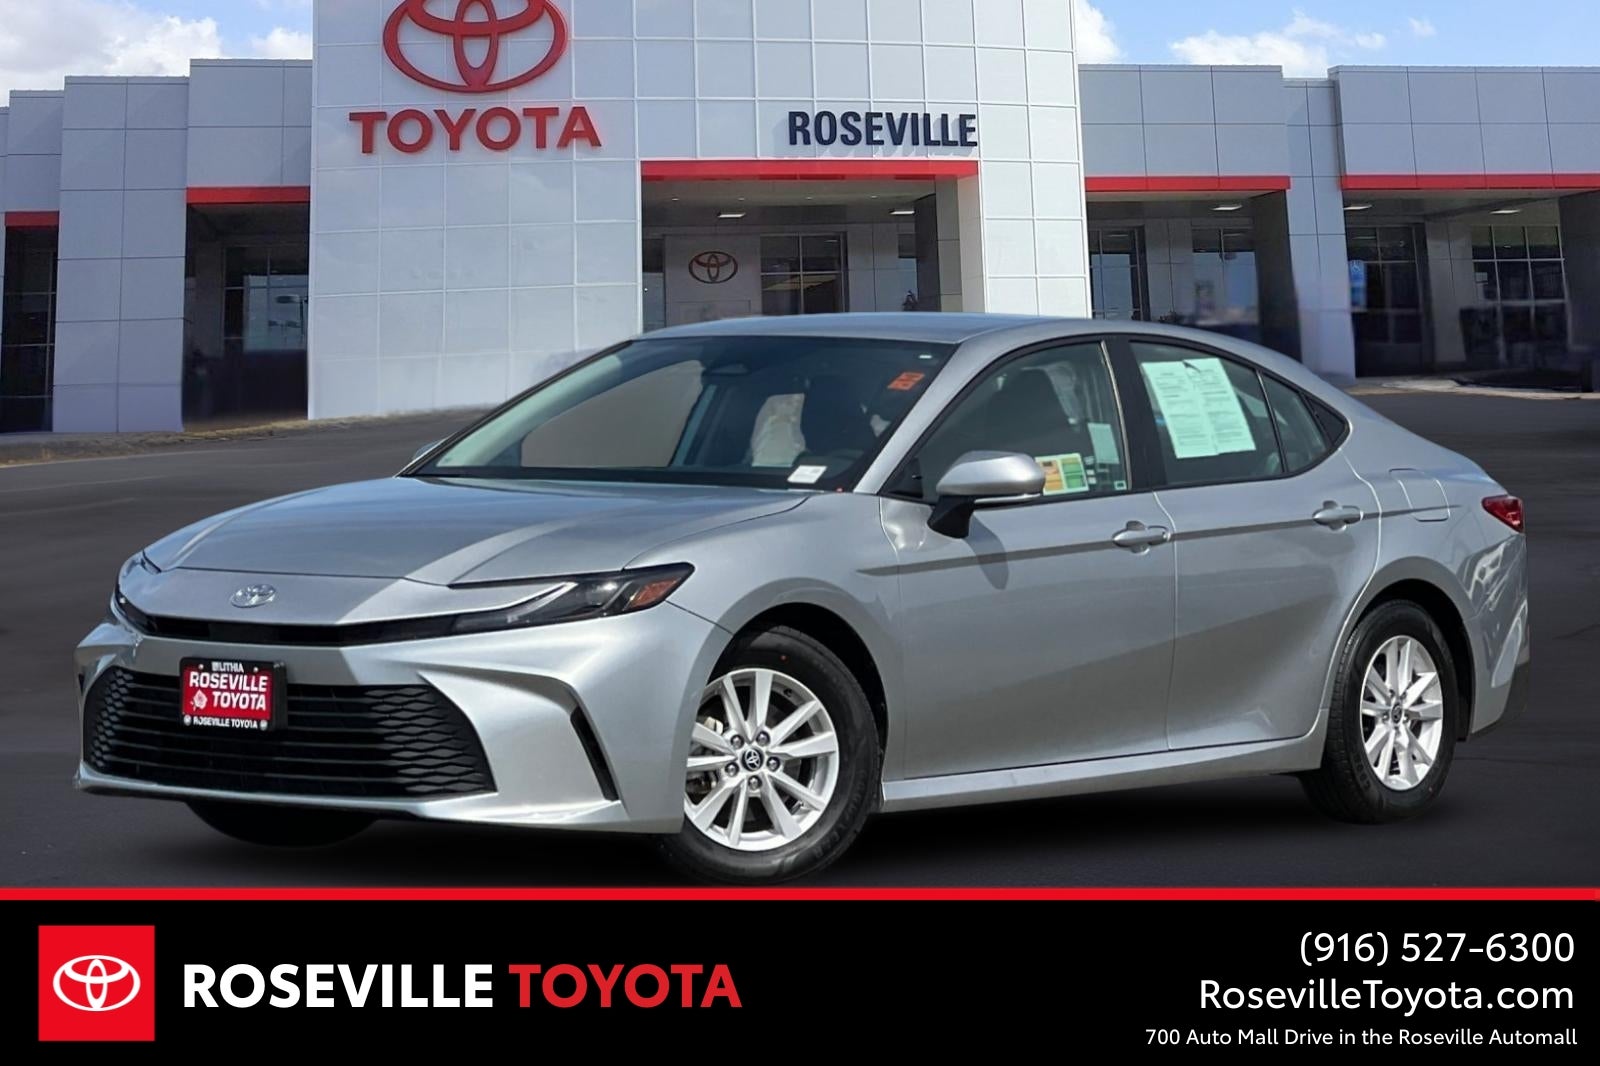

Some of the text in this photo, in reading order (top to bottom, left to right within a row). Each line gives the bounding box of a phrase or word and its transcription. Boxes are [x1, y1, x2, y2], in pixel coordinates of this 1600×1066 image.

[349, 106, 602, 154] TOYOTA
[788, 110, 978, 147] ROSEVILLE
[189, 671, 268, 692] ROSEVILLE
[212, 691, 266, 711] TOYOTA
[231, 718, 258, 729] TOYOTA
